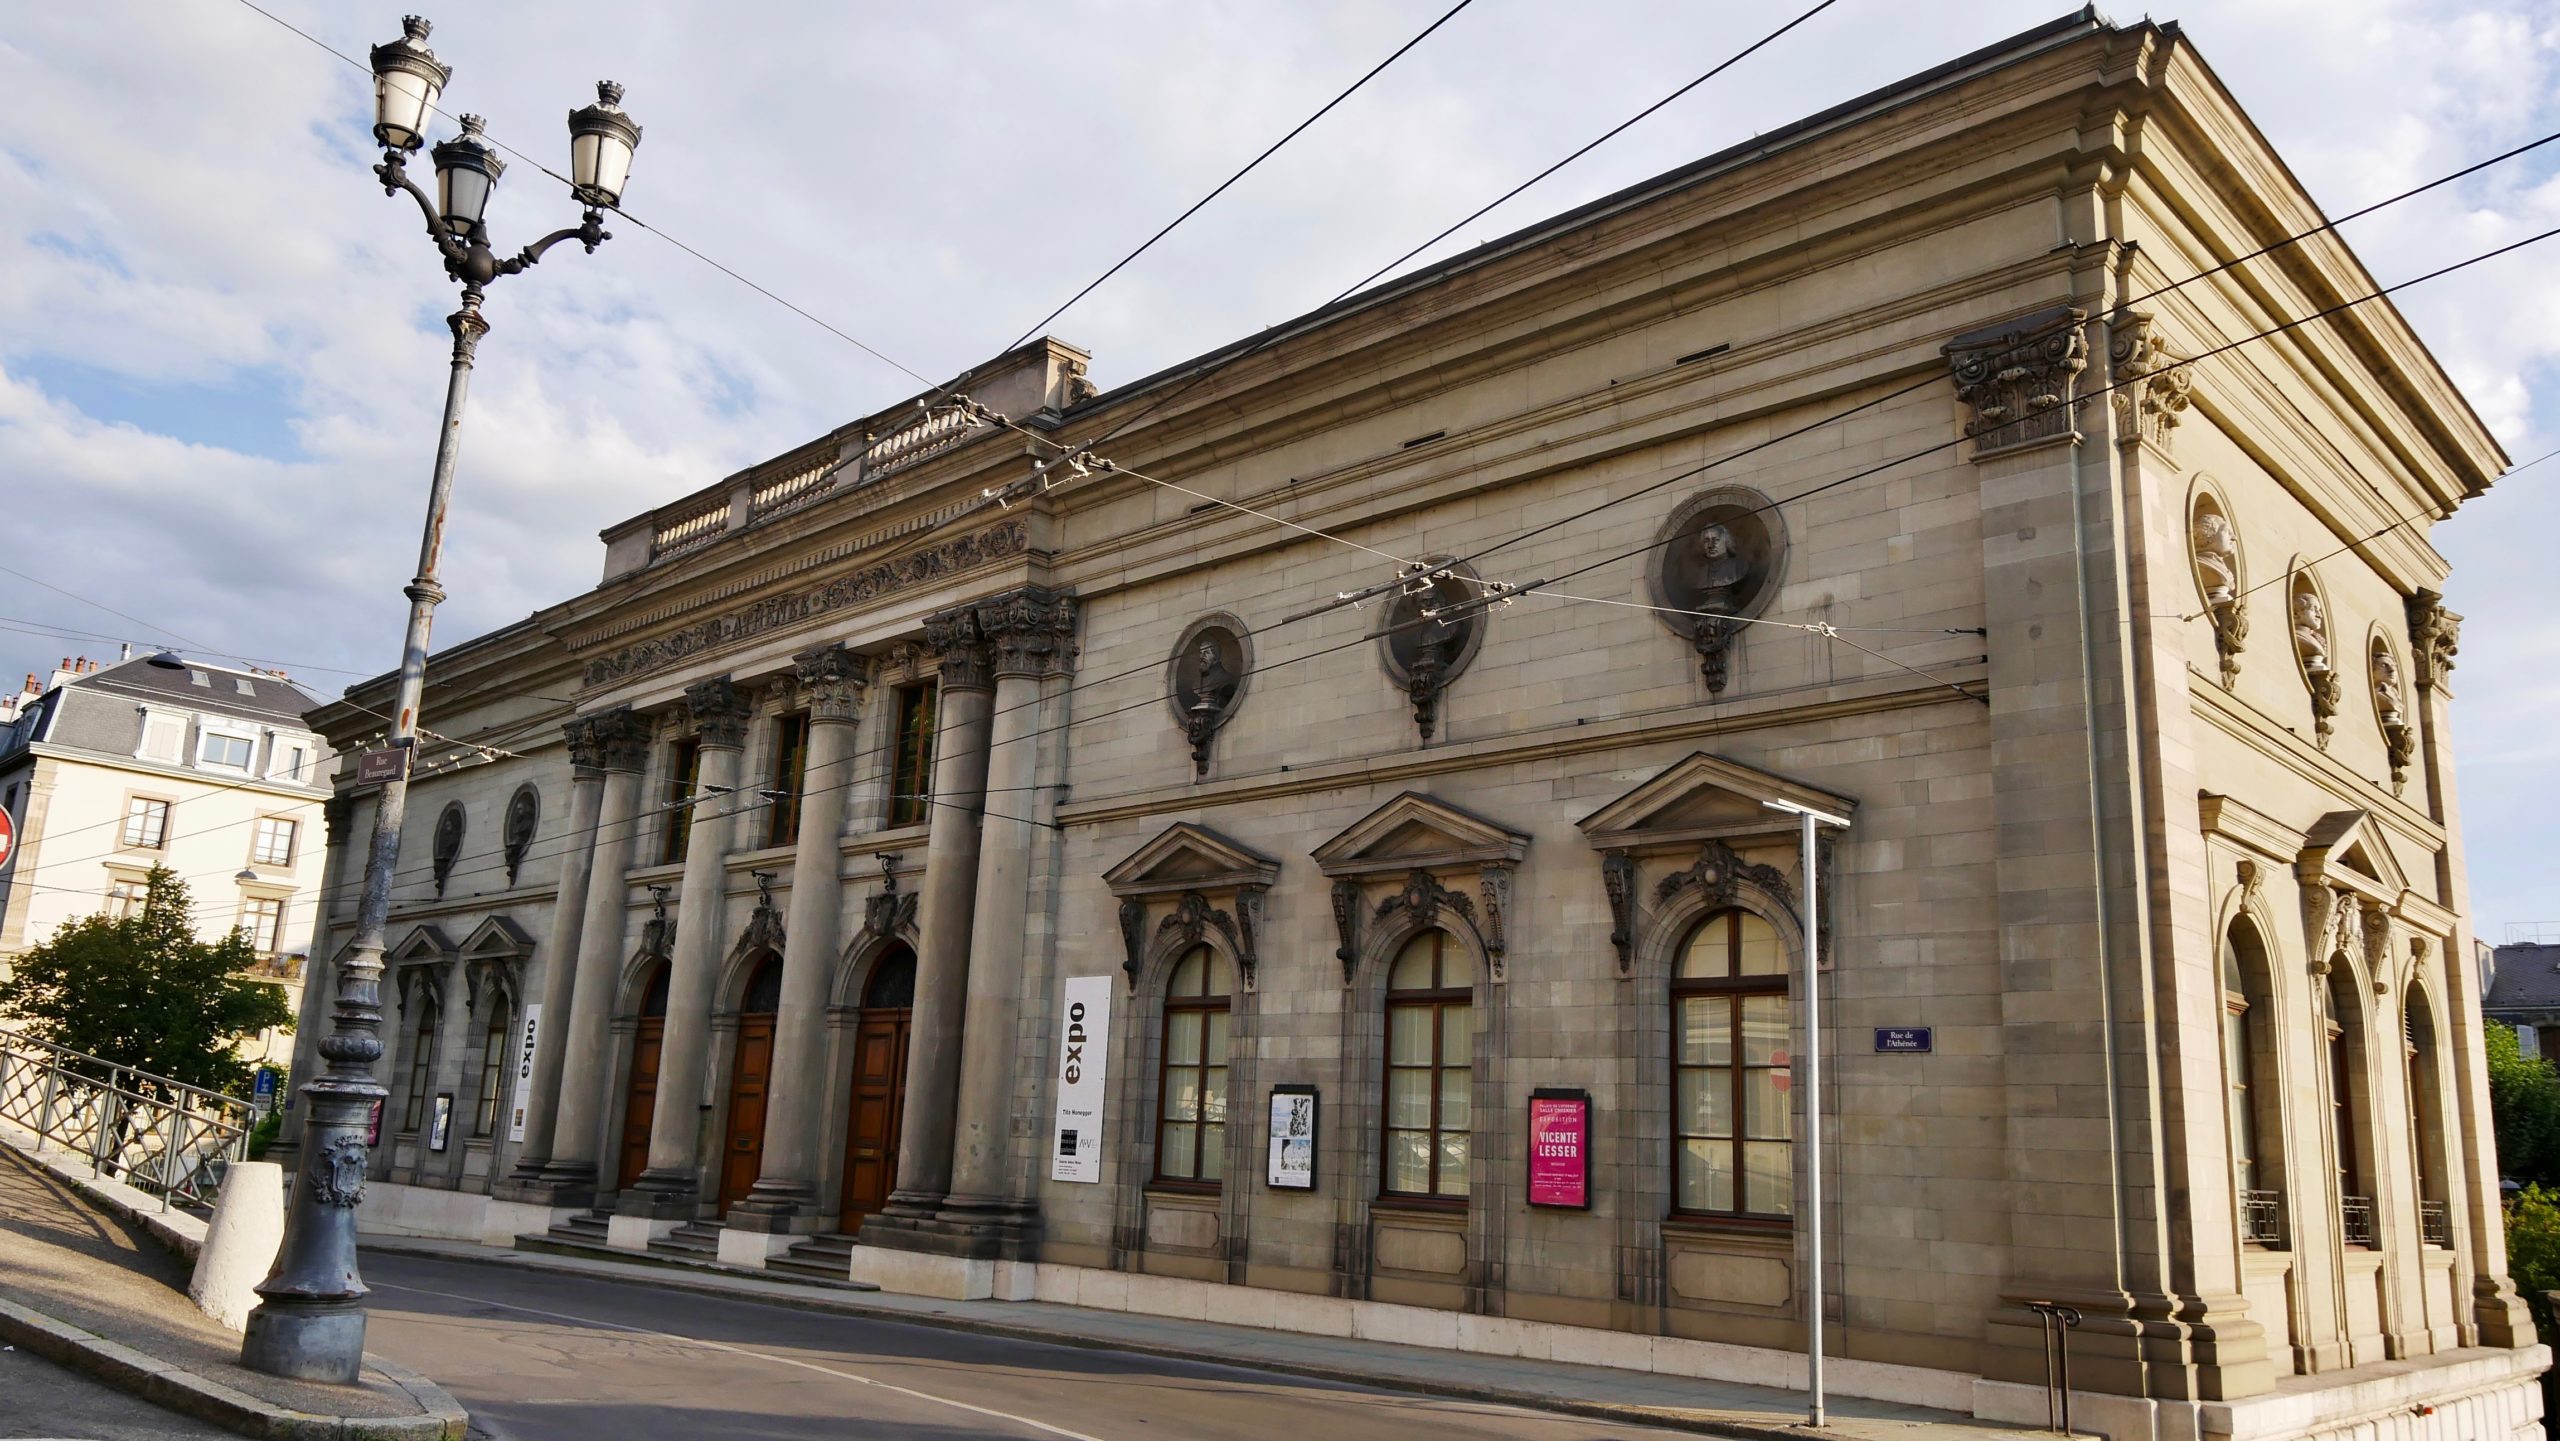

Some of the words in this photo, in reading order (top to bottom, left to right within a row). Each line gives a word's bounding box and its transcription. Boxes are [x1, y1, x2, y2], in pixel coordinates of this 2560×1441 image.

[376, 756, 388, 766] Rue
[1890, 1031, 1904, 1039] Rue
[1905, 1031, 1914, 1039] de
[521, 1019, 536, 1079] expo
[1065, 1002, 1088, 1085] expo
[1887, 1039, 1918, 1047] l'Athénée
[1540, 1131, 1577, 1143] VICENTE
[1539, 1145, 1577, 1158] LESSER
